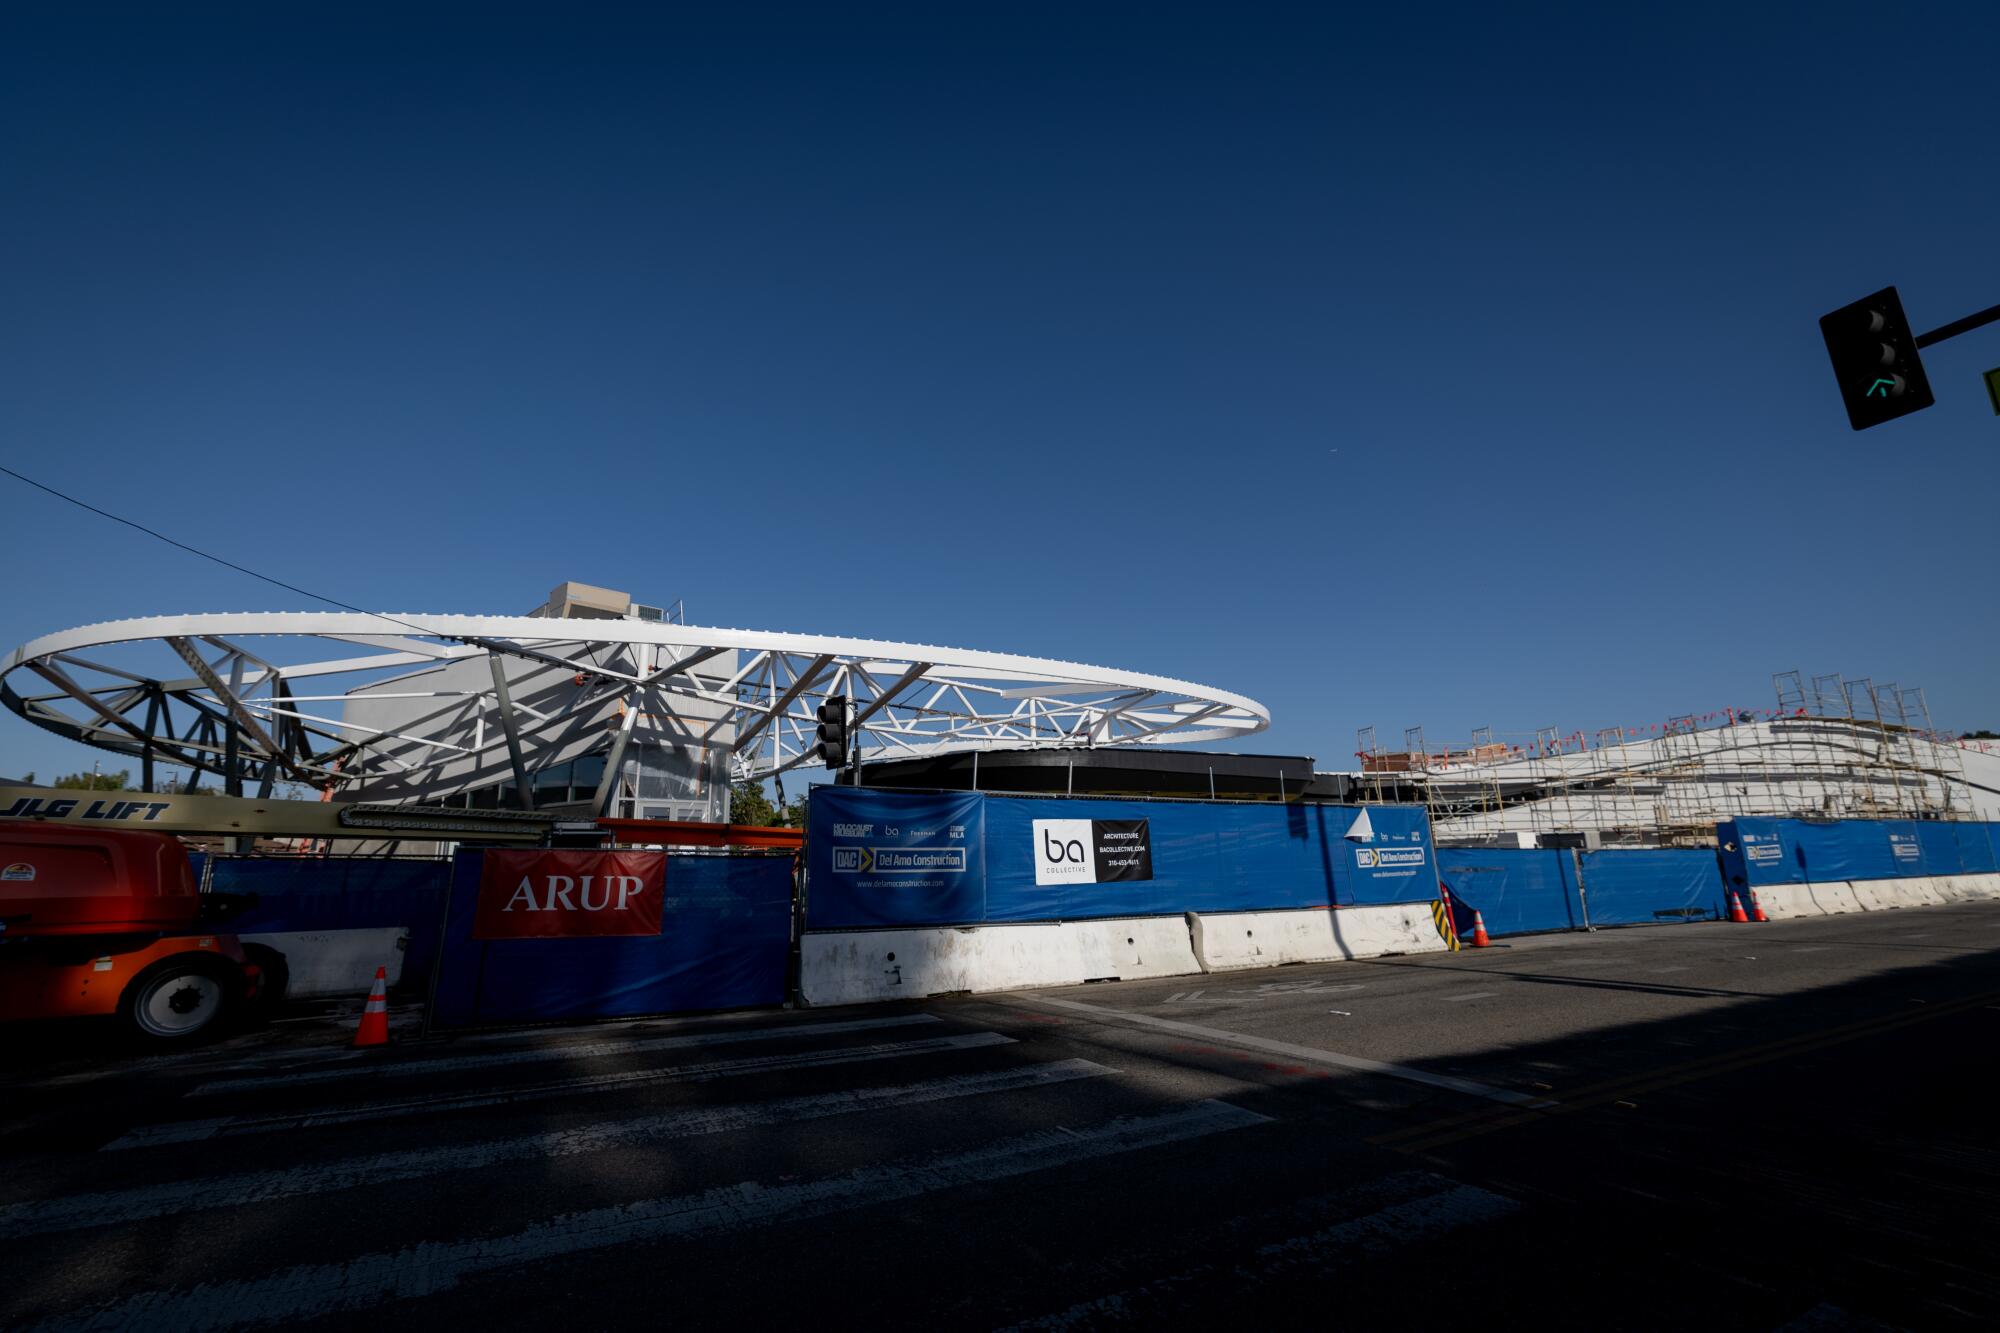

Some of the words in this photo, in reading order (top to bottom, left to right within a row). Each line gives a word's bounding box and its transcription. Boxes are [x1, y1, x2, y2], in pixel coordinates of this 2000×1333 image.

[0, 798, 79, 818] JLG
[82, 800, 170, 820] LIFT
[833, 823, 874, 832] HOLOCAUST
[1103, 832, 1139, 840] ARCHITECTURE
[1044, 829, 1085, 863] ba
[1099, 845, 1146, 853] BACOLLECTIVE.COM
[837, 851, 857, 868] DAC
[879, 853, 893, 866] Del
[893, 854, 912, 866] Amo
[913, 853, 960, 866] Construction
[501, 874, 644, 912] ARUP
